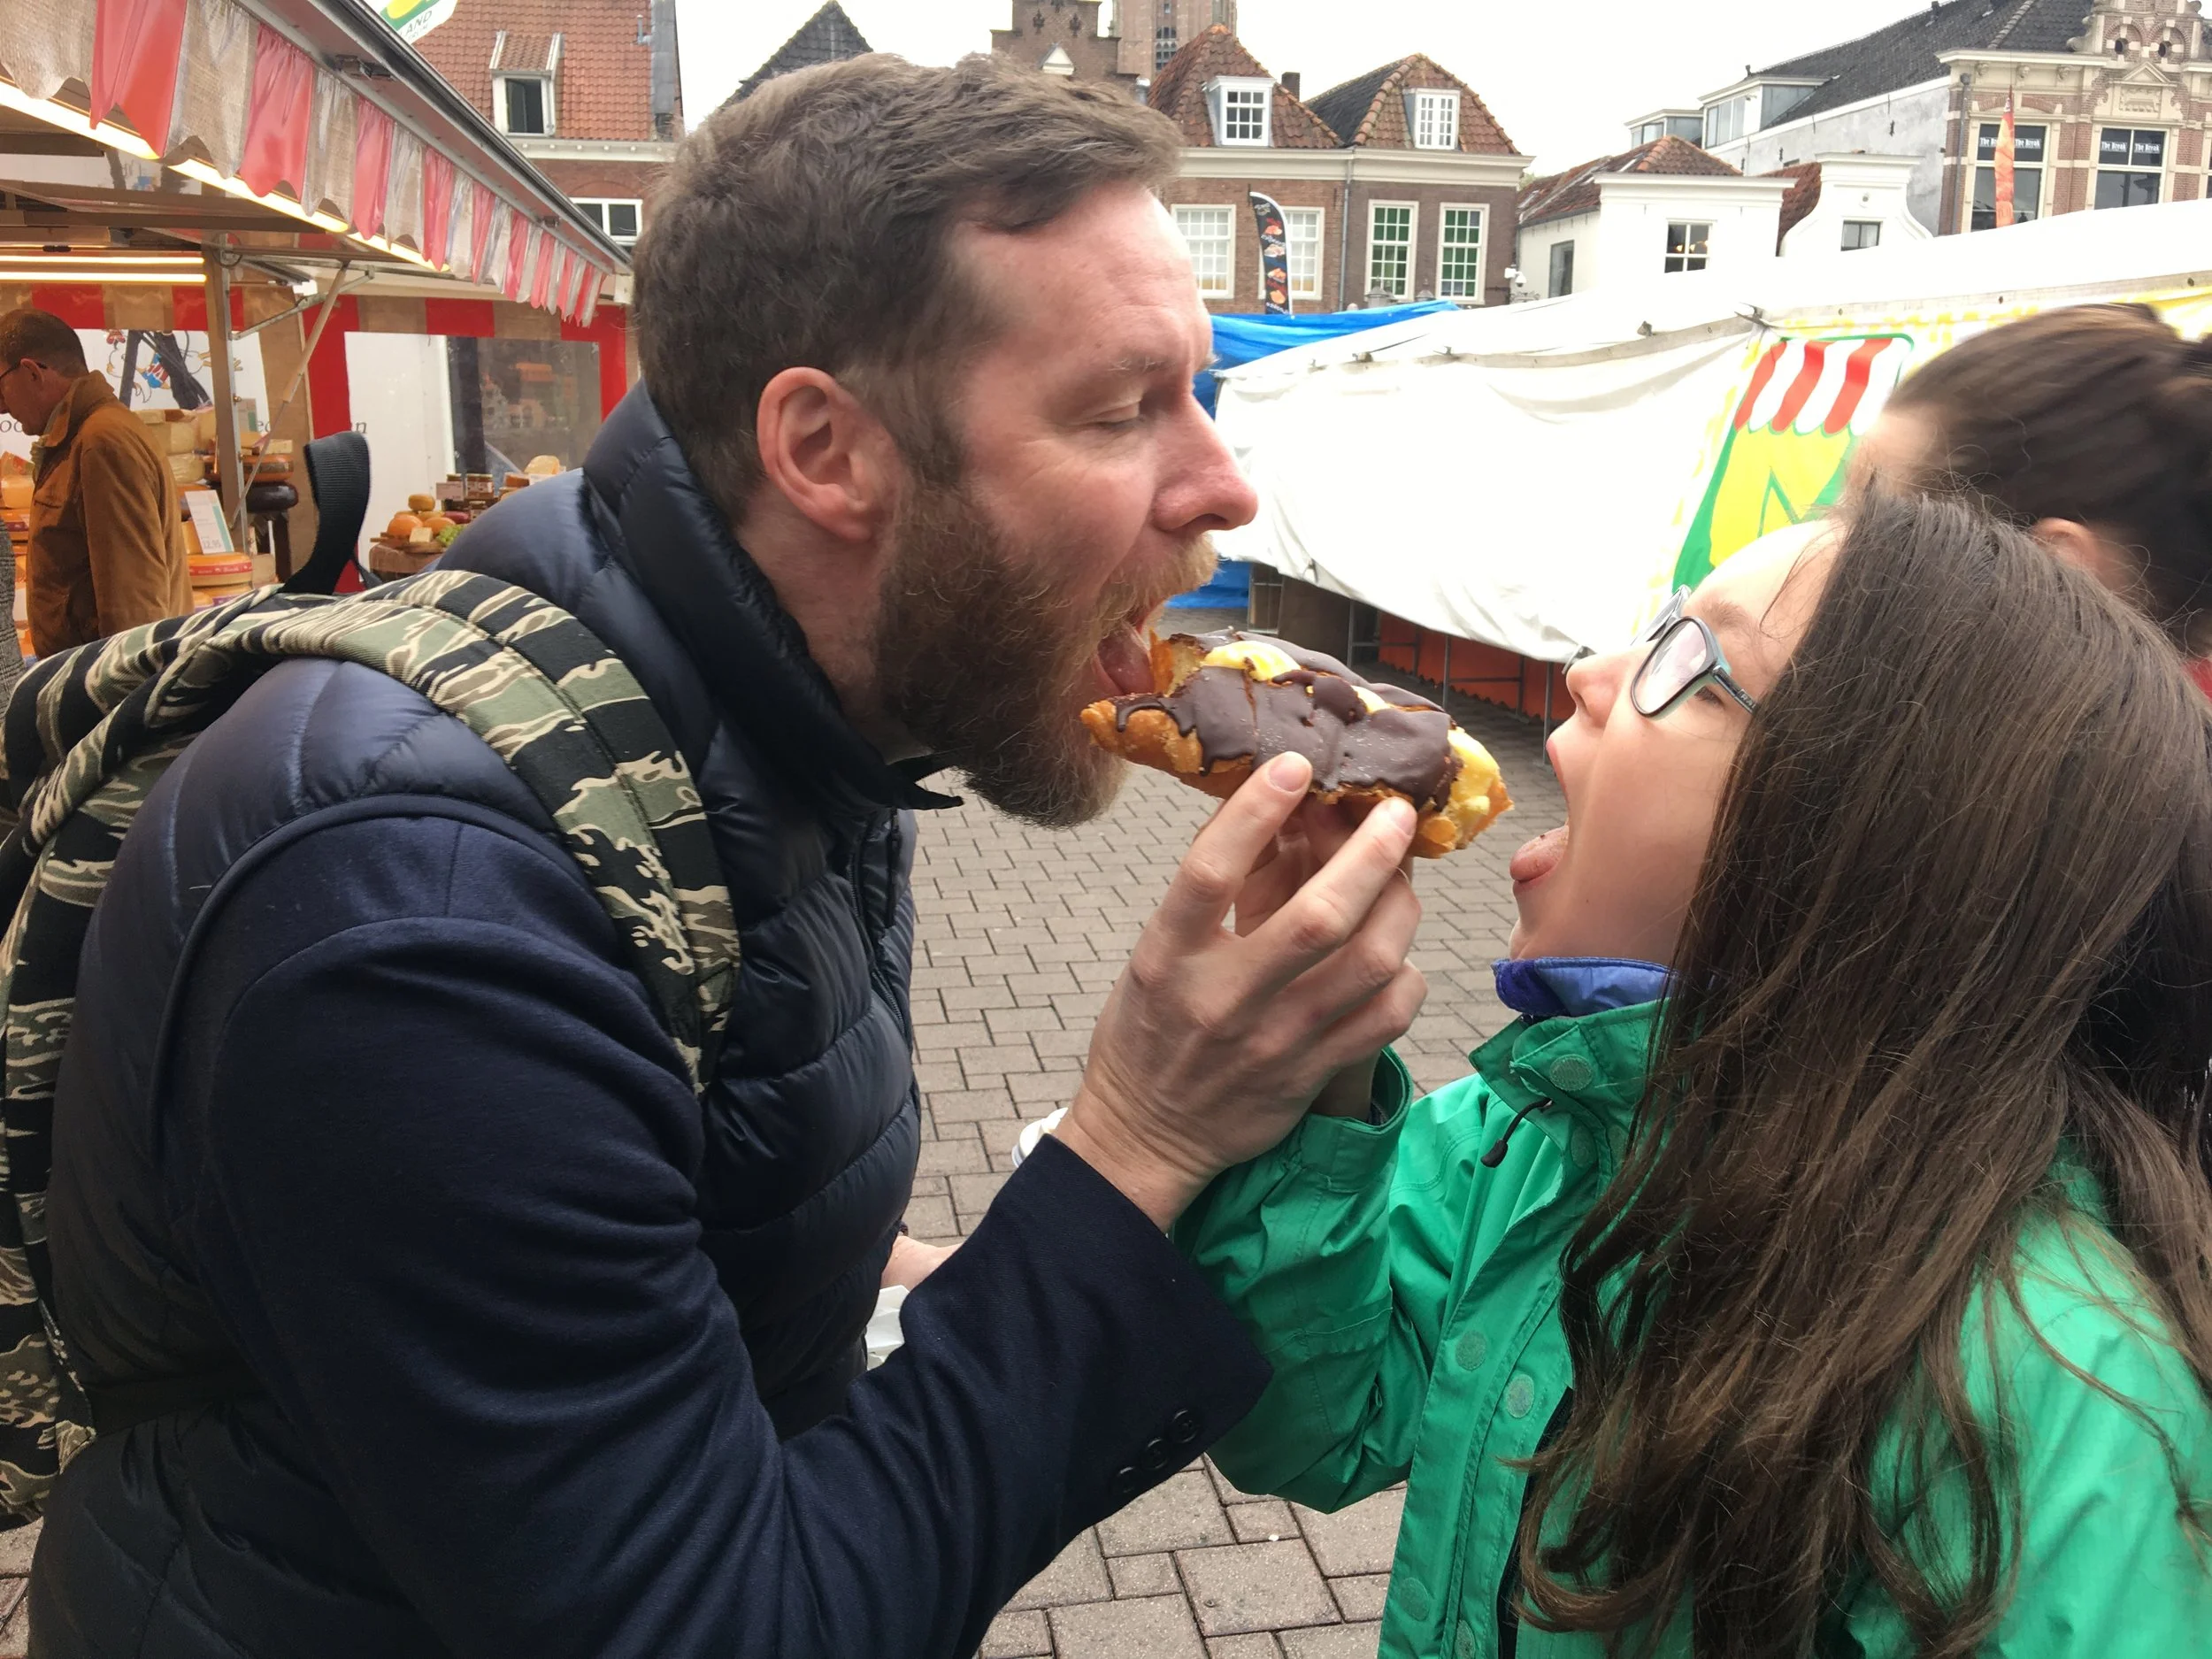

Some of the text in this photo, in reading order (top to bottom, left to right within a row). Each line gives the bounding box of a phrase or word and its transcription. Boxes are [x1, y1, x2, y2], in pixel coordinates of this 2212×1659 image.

[2015, 138, 2024, 148] The
[2101, 142, 2110, 150] The
[2135, 143, 2144, 152] The
